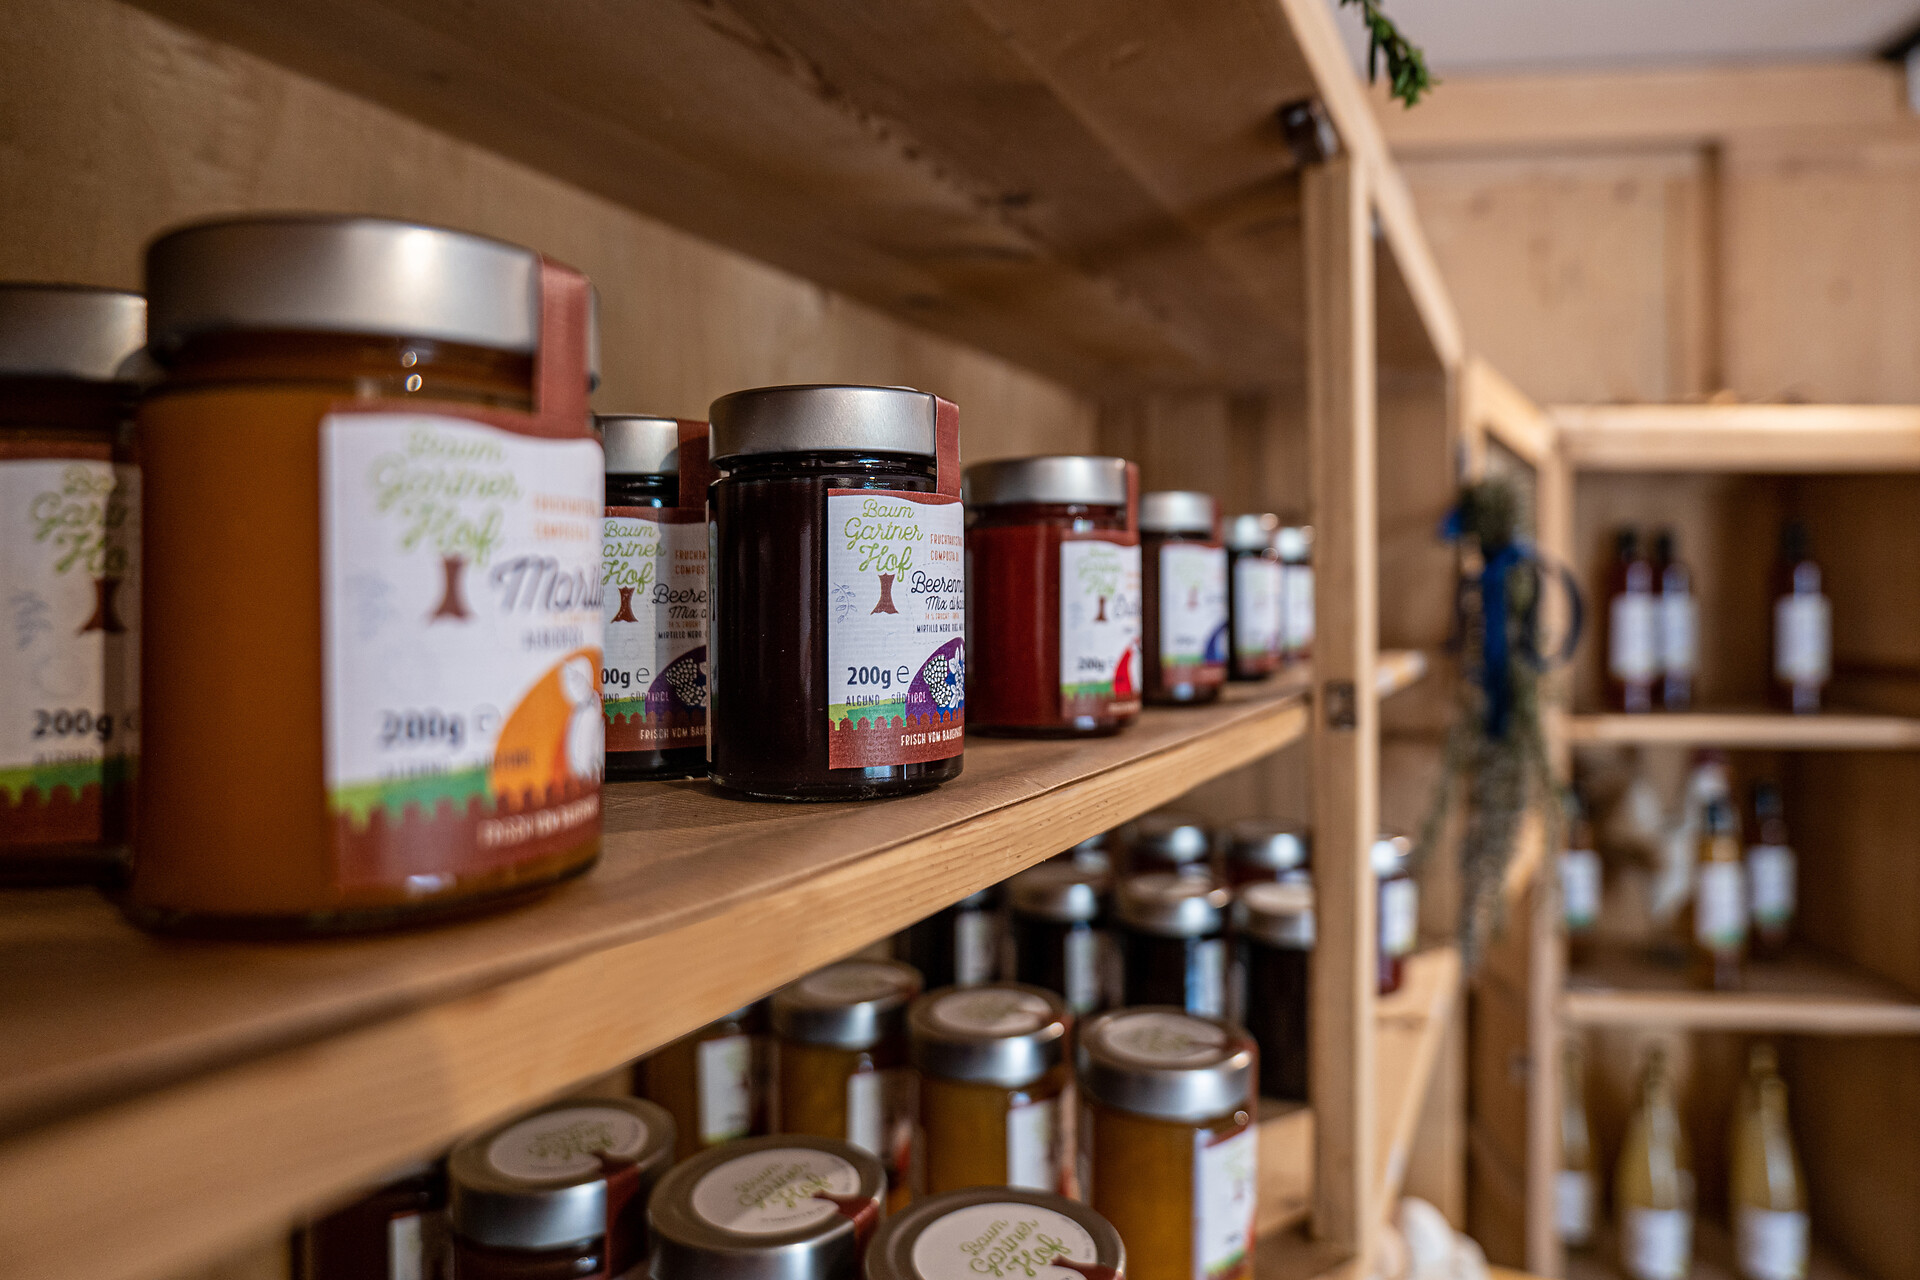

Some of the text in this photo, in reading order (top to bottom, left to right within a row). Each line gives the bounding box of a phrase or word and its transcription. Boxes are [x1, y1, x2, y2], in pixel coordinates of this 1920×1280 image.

[862, 498, 914, 518] Baum
[604, 520, 655, 538] Baum
[844, 517, 924, 550] Gartner
[602, 540, 666, 558] artner
[859, 543, 913, 583] Hof
[601, 559, 655, 595] Hof
[926, 595, 948, 610] Mix
[669, 605, 698, 619] Mix
[602, 667, 631, 689] 00g
[847, 666, 892, 689] 200g
[846, 691, 927, 707] ALGUND SÜDTIROL
[640, 728, 669, 740] FRISCH
[671, 726, 688, 738] VOM
[900, 734, 926, 747] FRISCH
